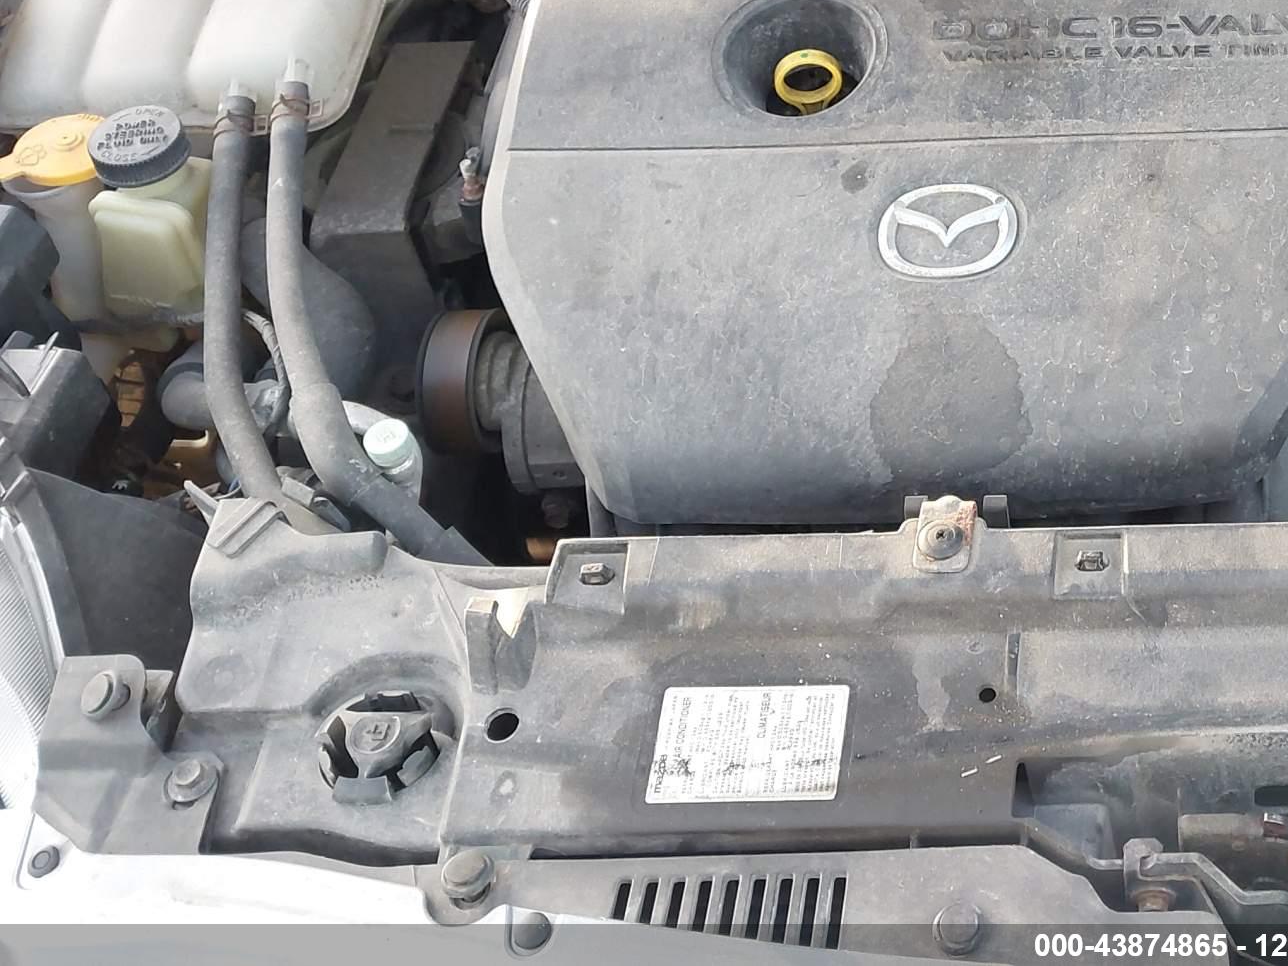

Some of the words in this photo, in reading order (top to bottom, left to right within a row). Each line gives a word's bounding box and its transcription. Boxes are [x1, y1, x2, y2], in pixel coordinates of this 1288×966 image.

[933, 16, 1098, 41] DOHC
[942, 45, 1103, 64] VARIABLE
[1114, 44, 1212, 59] VALVE
[100, 150, 139, 163] CLOSE
[675, 697, 692, 744] CONDITIONER
[756, 692, 771, 739] CLIMATISEUR
